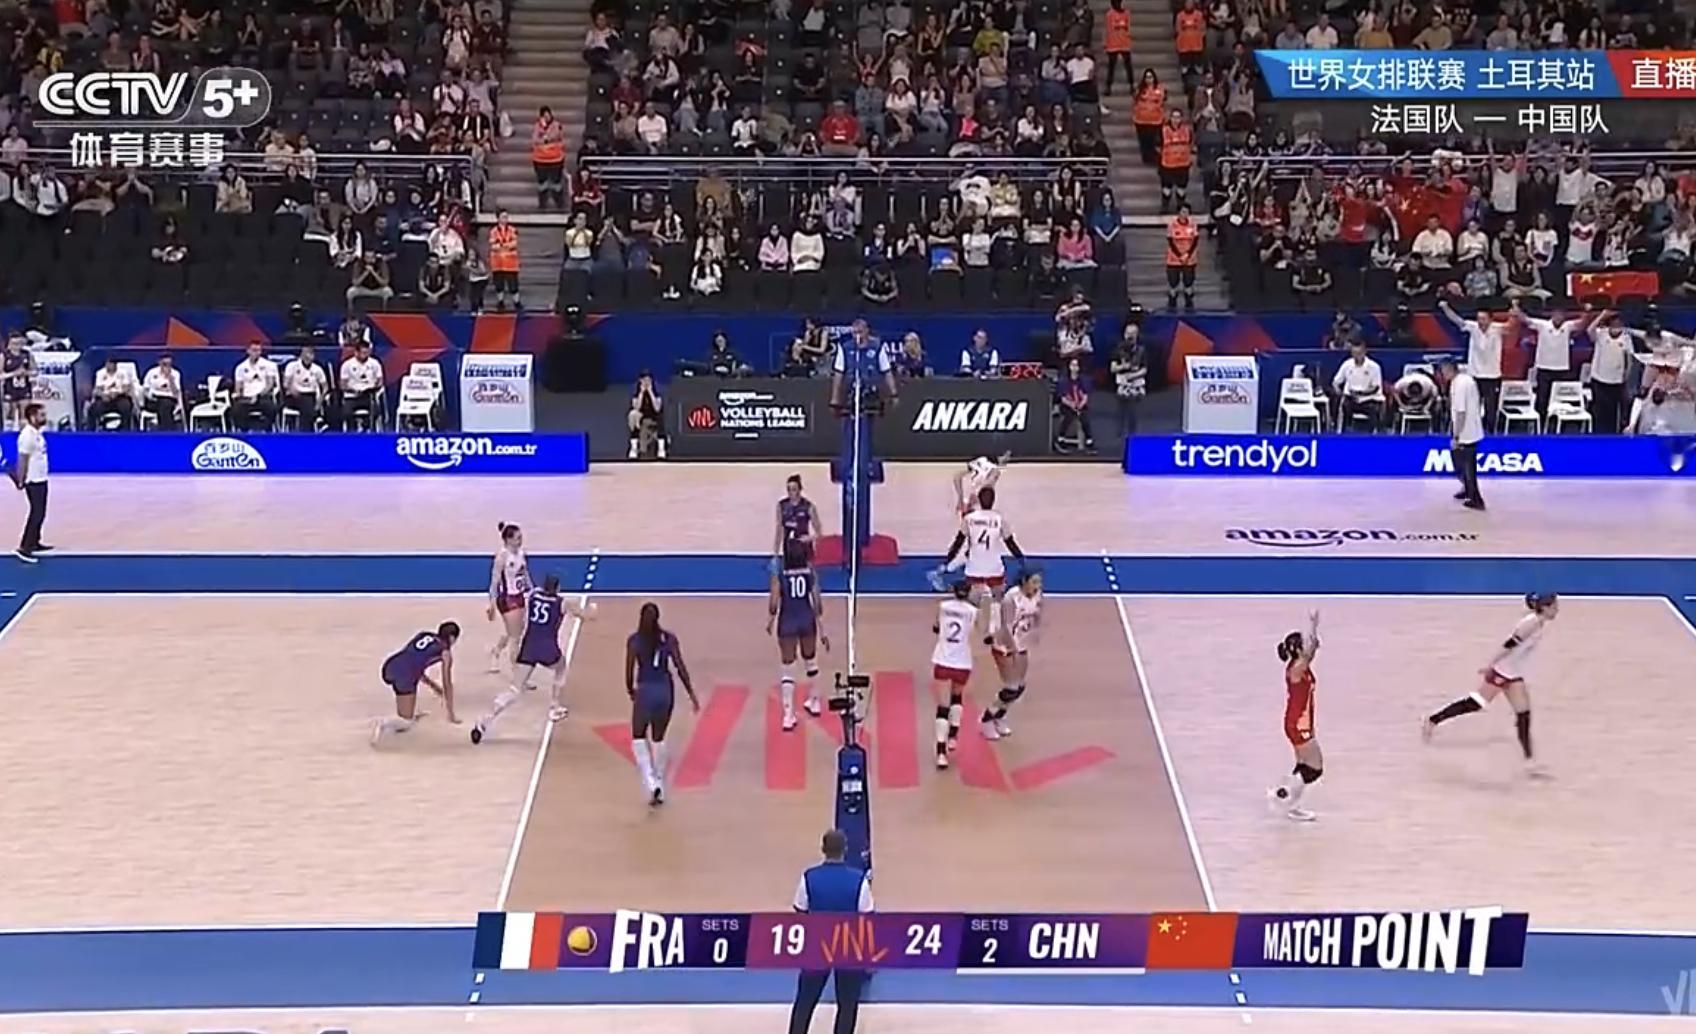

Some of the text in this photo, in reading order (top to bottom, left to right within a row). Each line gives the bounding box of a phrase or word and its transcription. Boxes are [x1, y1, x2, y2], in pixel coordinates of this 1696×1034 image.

[720, 407, 805, 418] VOLLEYBALL
[720, 419, 805, 427] NATIONS LEAGUE
[913, 402, 1029, 431] ANKARA
[396, 436, 537, 458] amazon.com.tr
[1172, 438, 1318, 473] trendyol
[1422, 448, 1544, 472] MASA
[978, 530, 991, 551] 4
[1225, 527, 1480, 544] amazon.com.tr
[789, 576, 806, 598] 10
[530, 599, 552, 625] 35
[946, 622, 962, 643] 2
